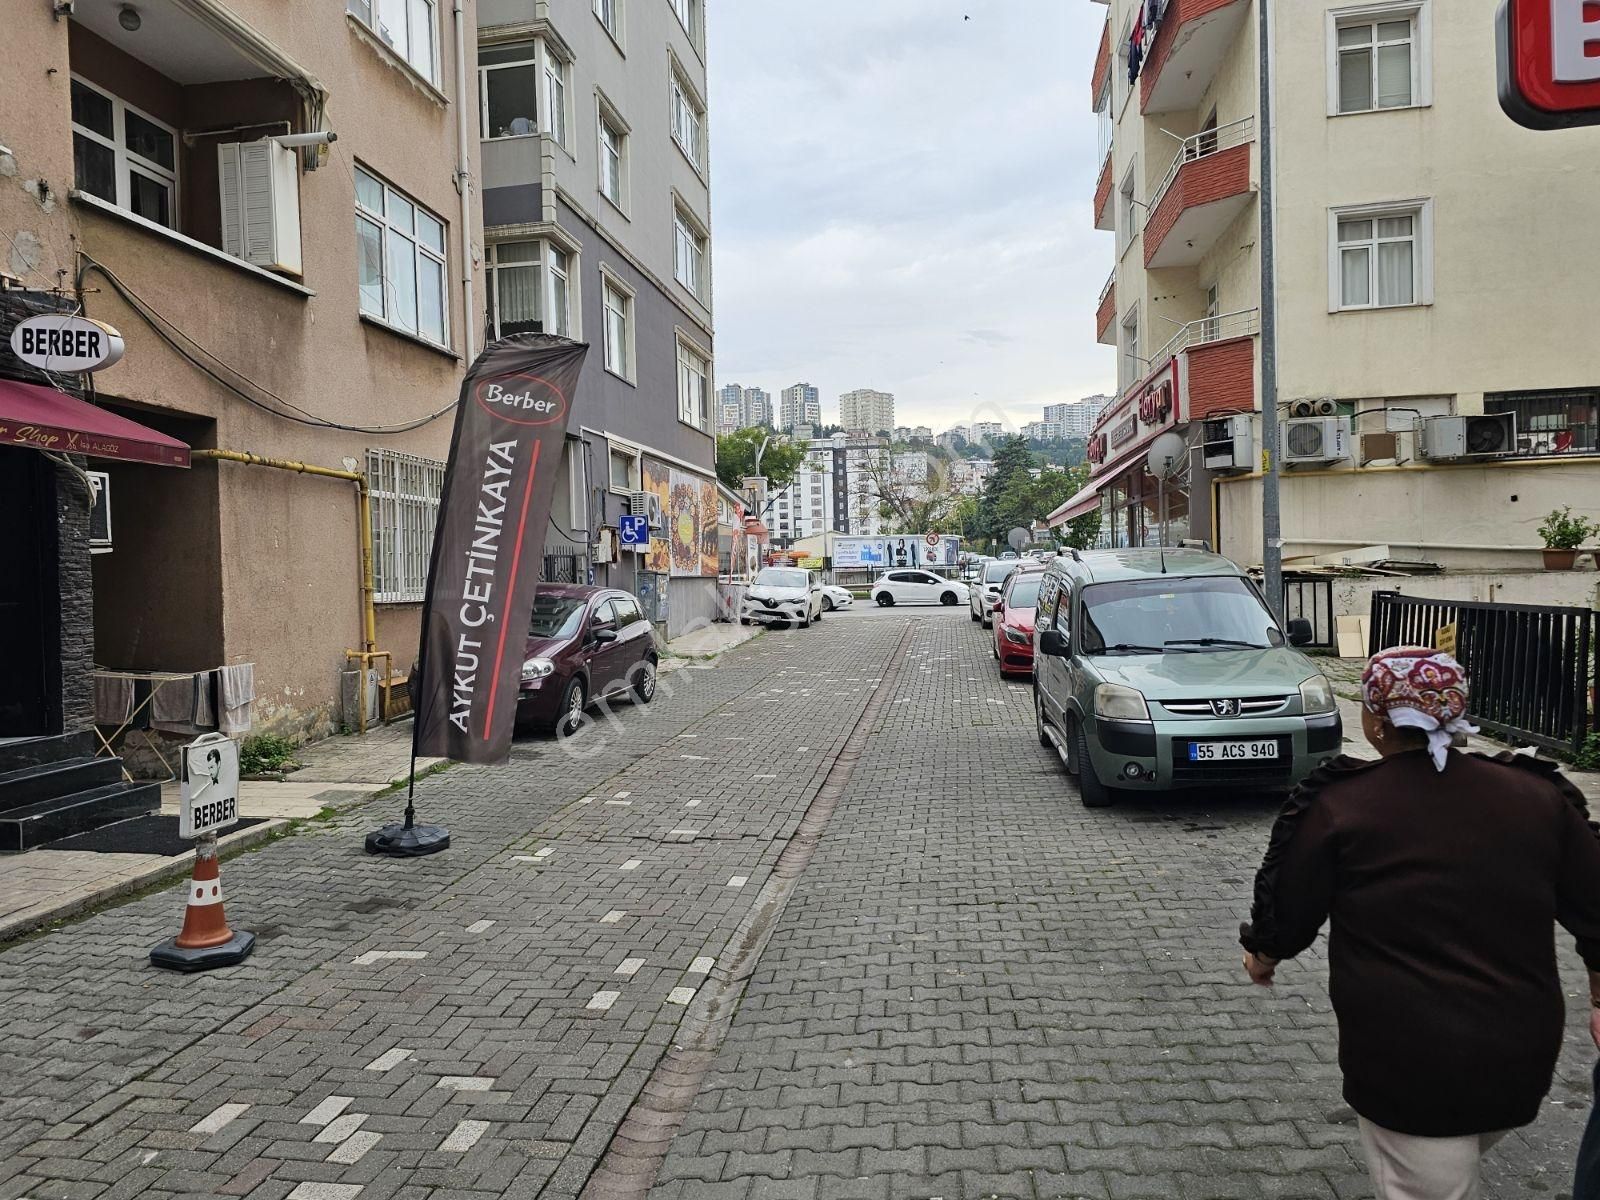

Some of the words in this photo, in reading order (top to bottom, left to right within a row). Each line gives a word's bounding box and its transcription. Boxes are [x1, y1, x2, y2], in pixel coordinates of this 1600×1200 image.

[22, 328, 100, 358] BERBER
[486, 384, 557, 414] Berber
[13, 426, 59, 447] Shop
[459, 439, 518, 628] ÇETİNKAYA
[634, 517, 646, 531] P
[449, 633, 482, 735] AYKUT
[1199, 746, 1214, 758] 55
[1222, 744, 1246, 758] ACS
[1251, 743, 1275, 757] 940
[194, 796, 236, 830] BERBER
